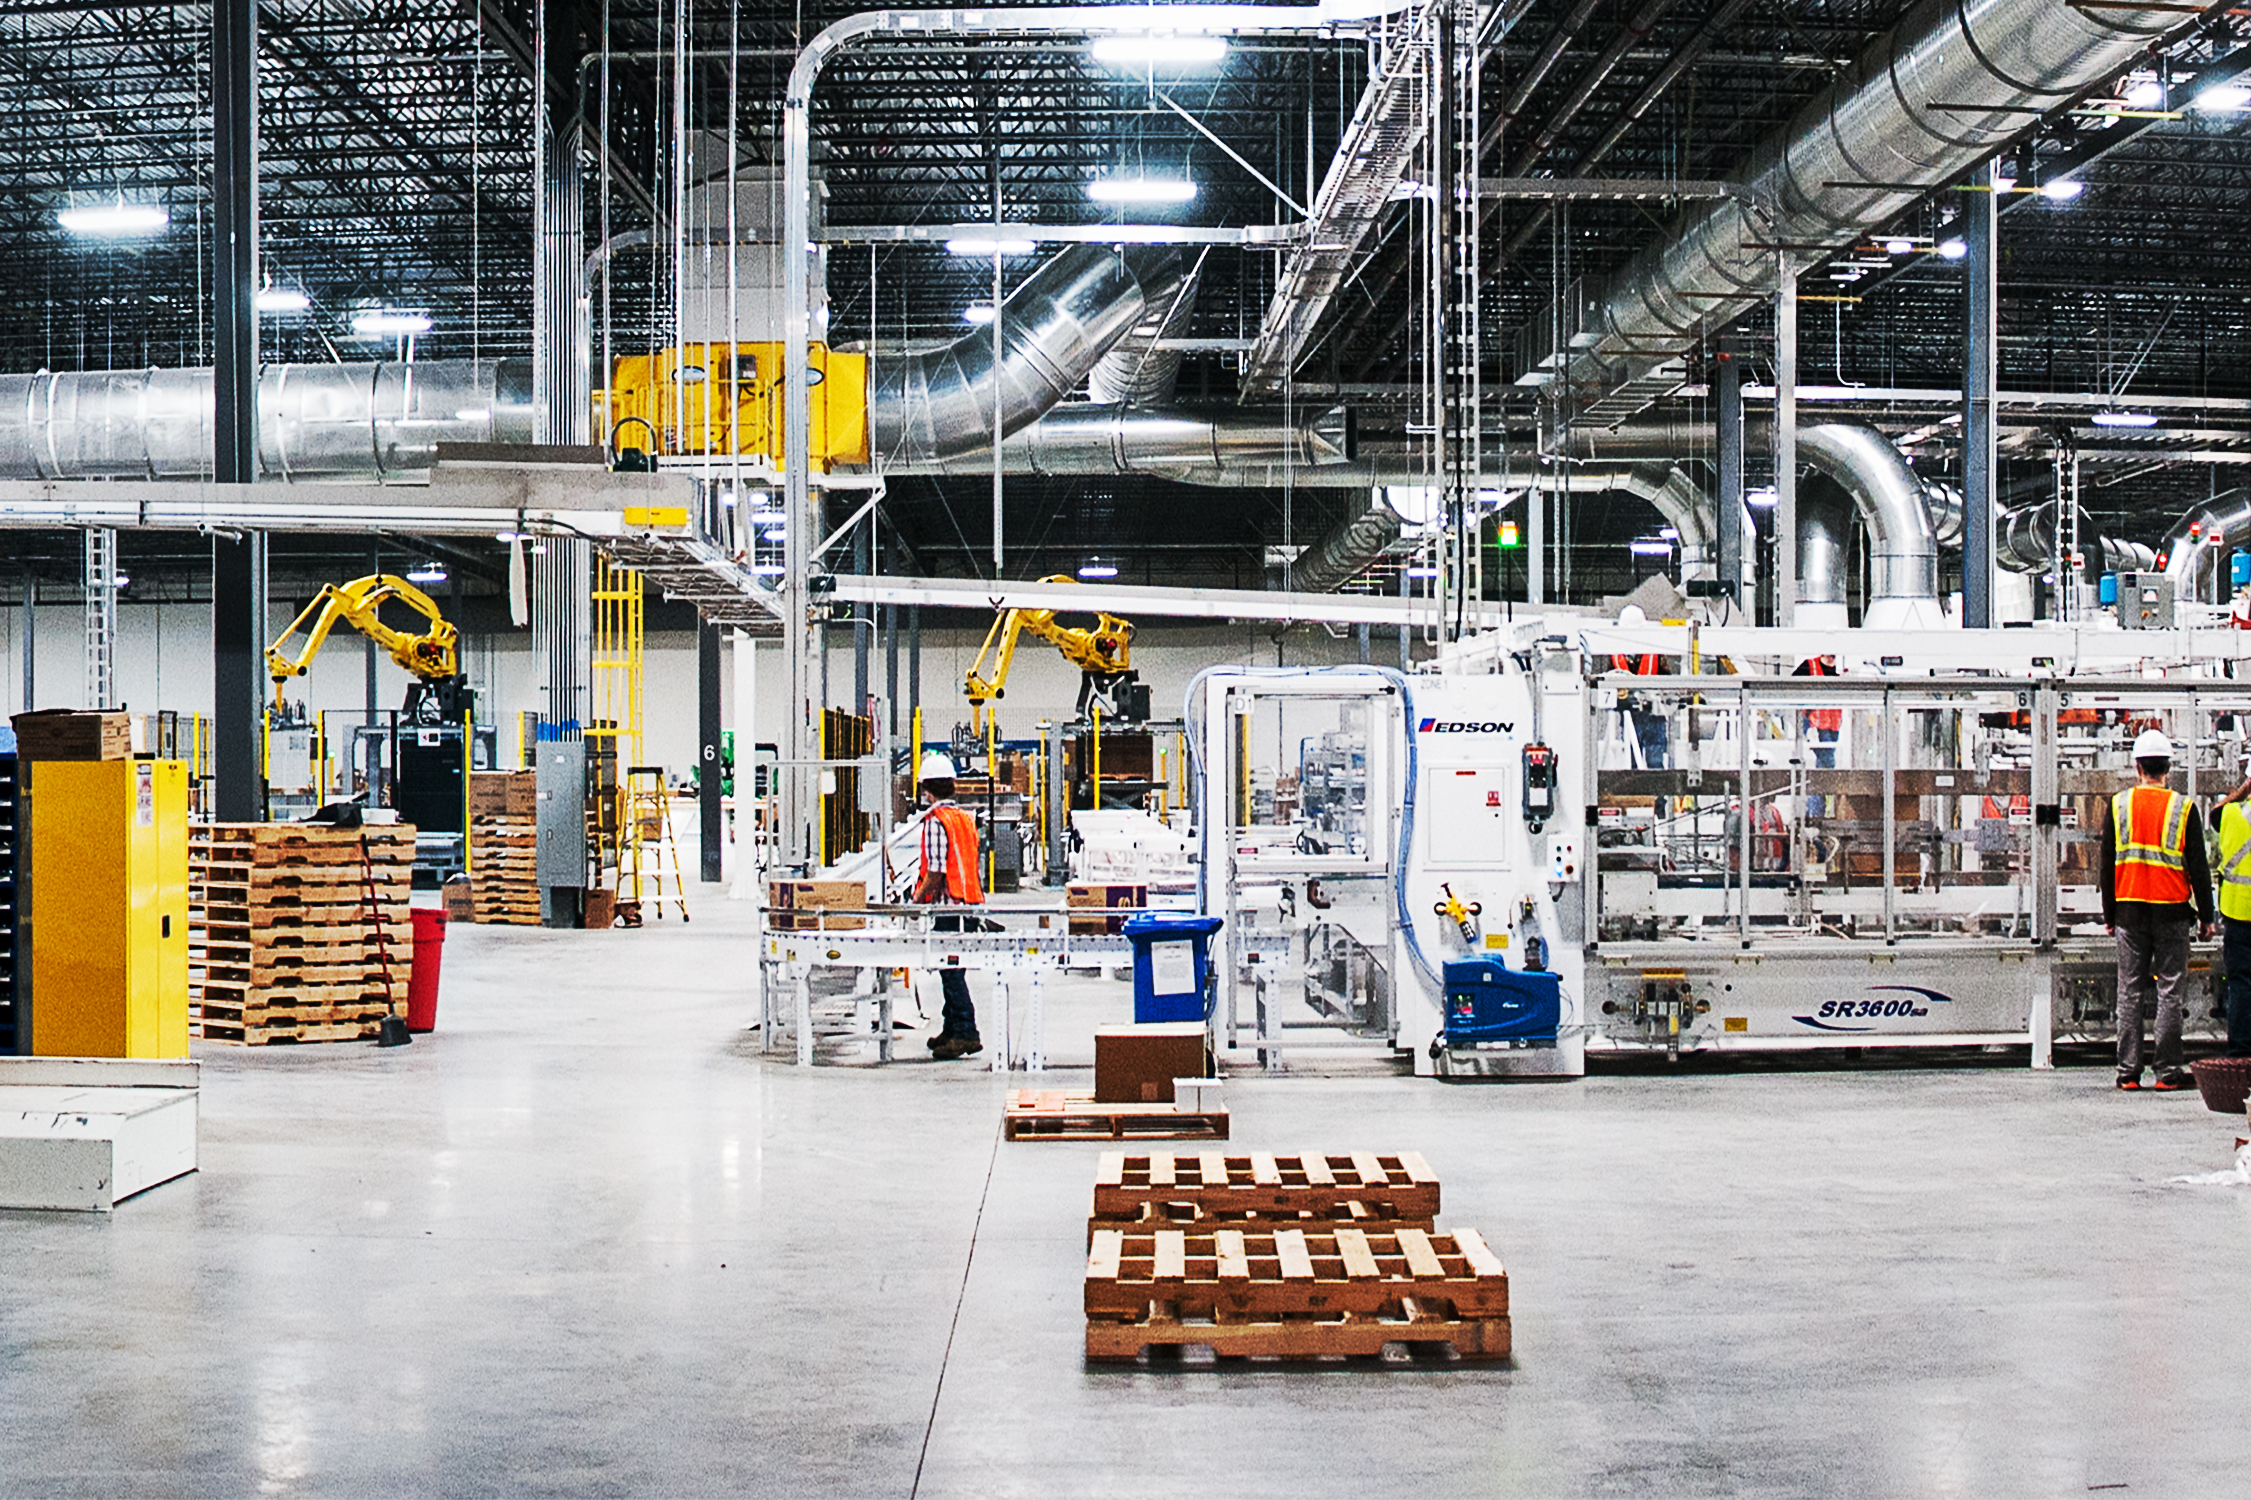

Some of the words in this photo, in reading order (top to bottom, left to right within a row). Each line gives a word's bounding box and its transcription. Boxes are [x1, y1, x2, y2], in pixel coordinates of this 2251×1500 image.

[1421, 679, 1441, 690] ZONE
[1235, 697, 1252, 711] D1
[1604, 691, 1611, 704] 7
[2019, 692, 2027, 707] 6
[2060, 692, 2069, 707] 5
[1434, 722, 1515, 733] EDSON
[703, 744, 716, 761] 6
